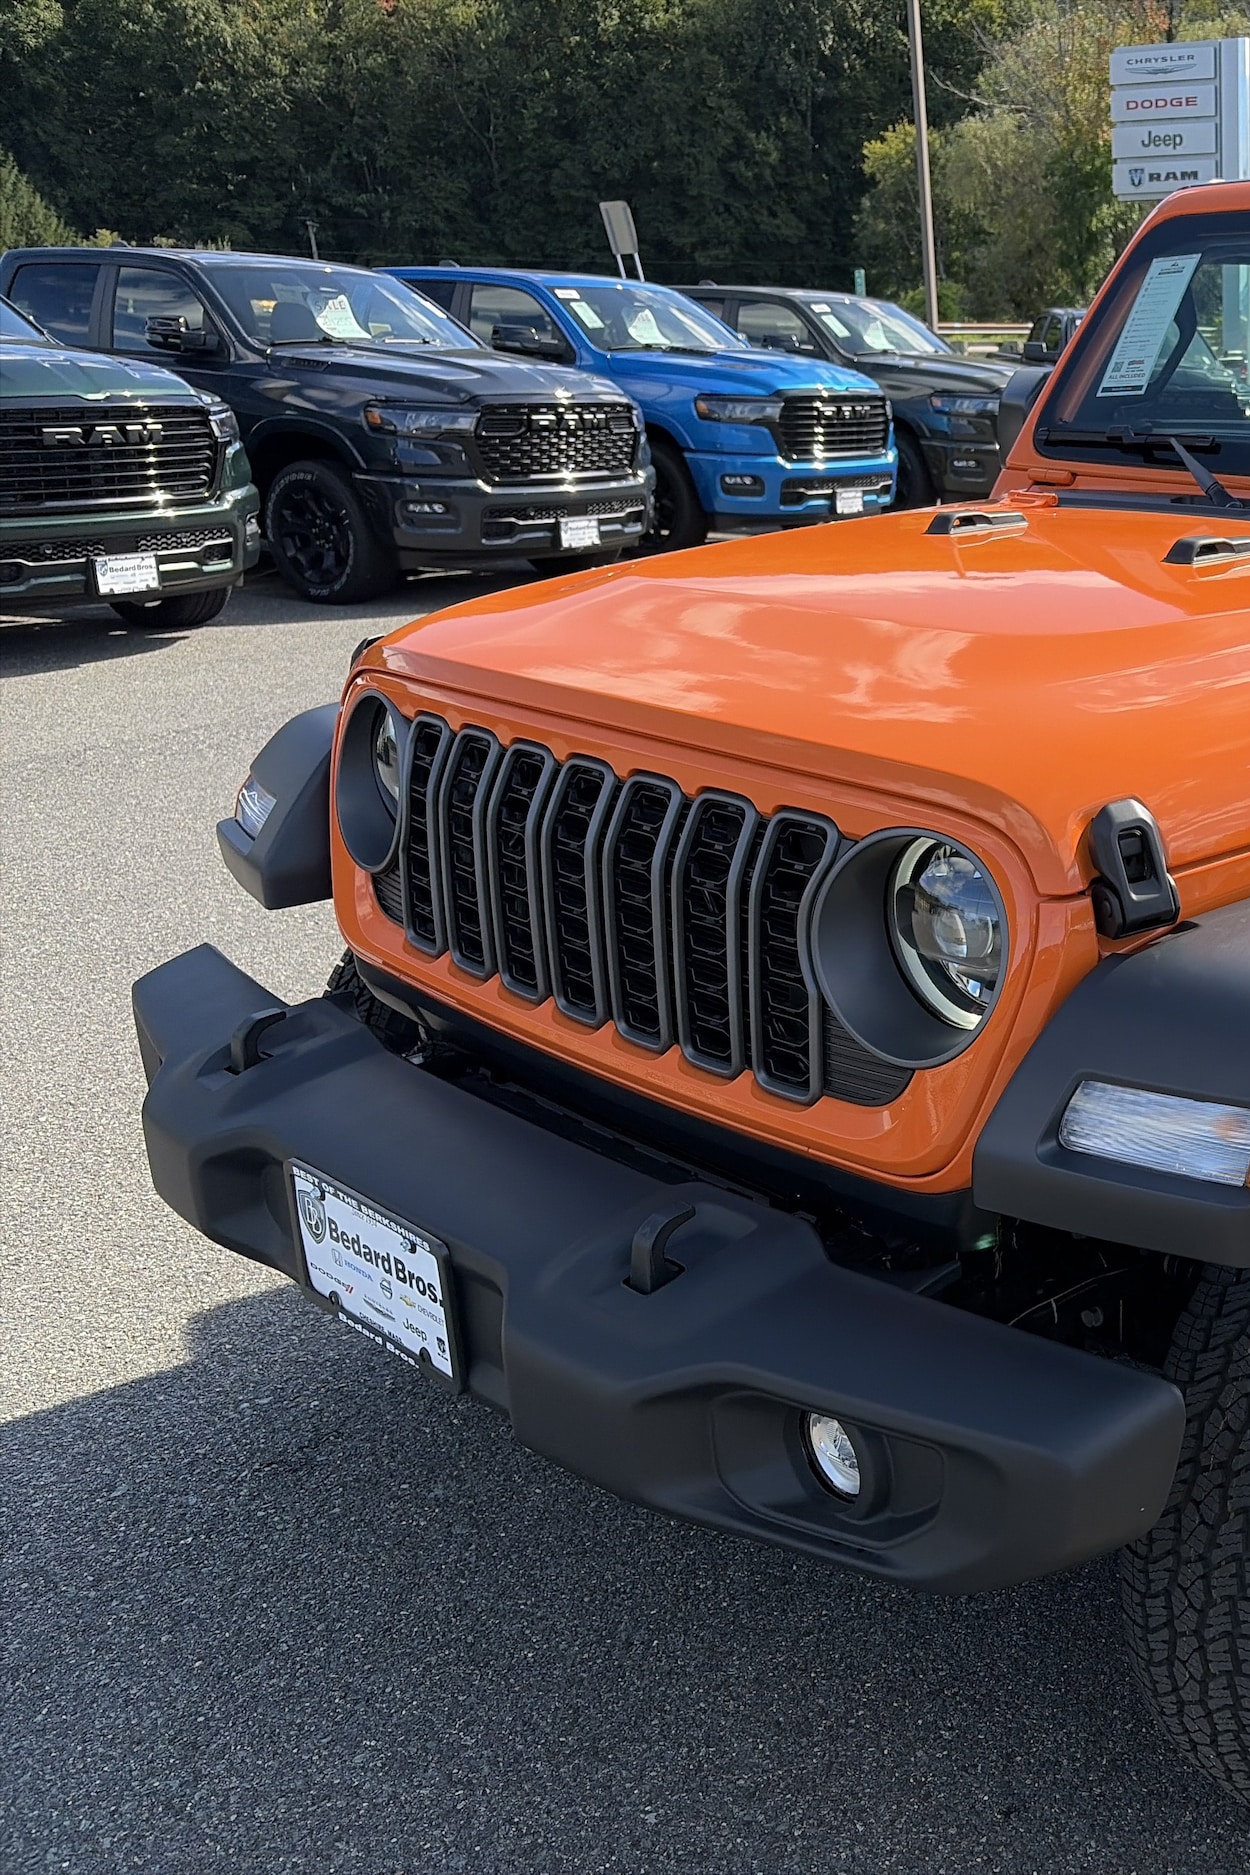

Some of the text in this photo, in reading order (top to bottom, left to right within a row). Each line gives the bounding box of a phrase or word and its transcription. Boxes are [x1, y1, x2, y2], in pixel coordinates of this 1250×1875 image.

[1126, 54, 1196, 66] CHRYSLER
[1126, 96, 1198, 111] DODGE
[1141, 130, 1184, 150] Jeep
[1148, 170, 1199, 182] RAM
[530, 414, 606, 429] RAM
[42, 424, 163, 445] RAM
[109, 564, 136, 573] Bedard
[292, 1166, 430, 1252] BEST OF THE BERKSHIRES
[327, 1216, 444, 1307] Bedard Bros.
[344, 1259, 374, 1282] HONDA
[310, 1262, 347, 1288] DODGE
[338, 1312, 420, 1369] Bedard Bros.
[402, 1318, 428, 1343] Jeep
